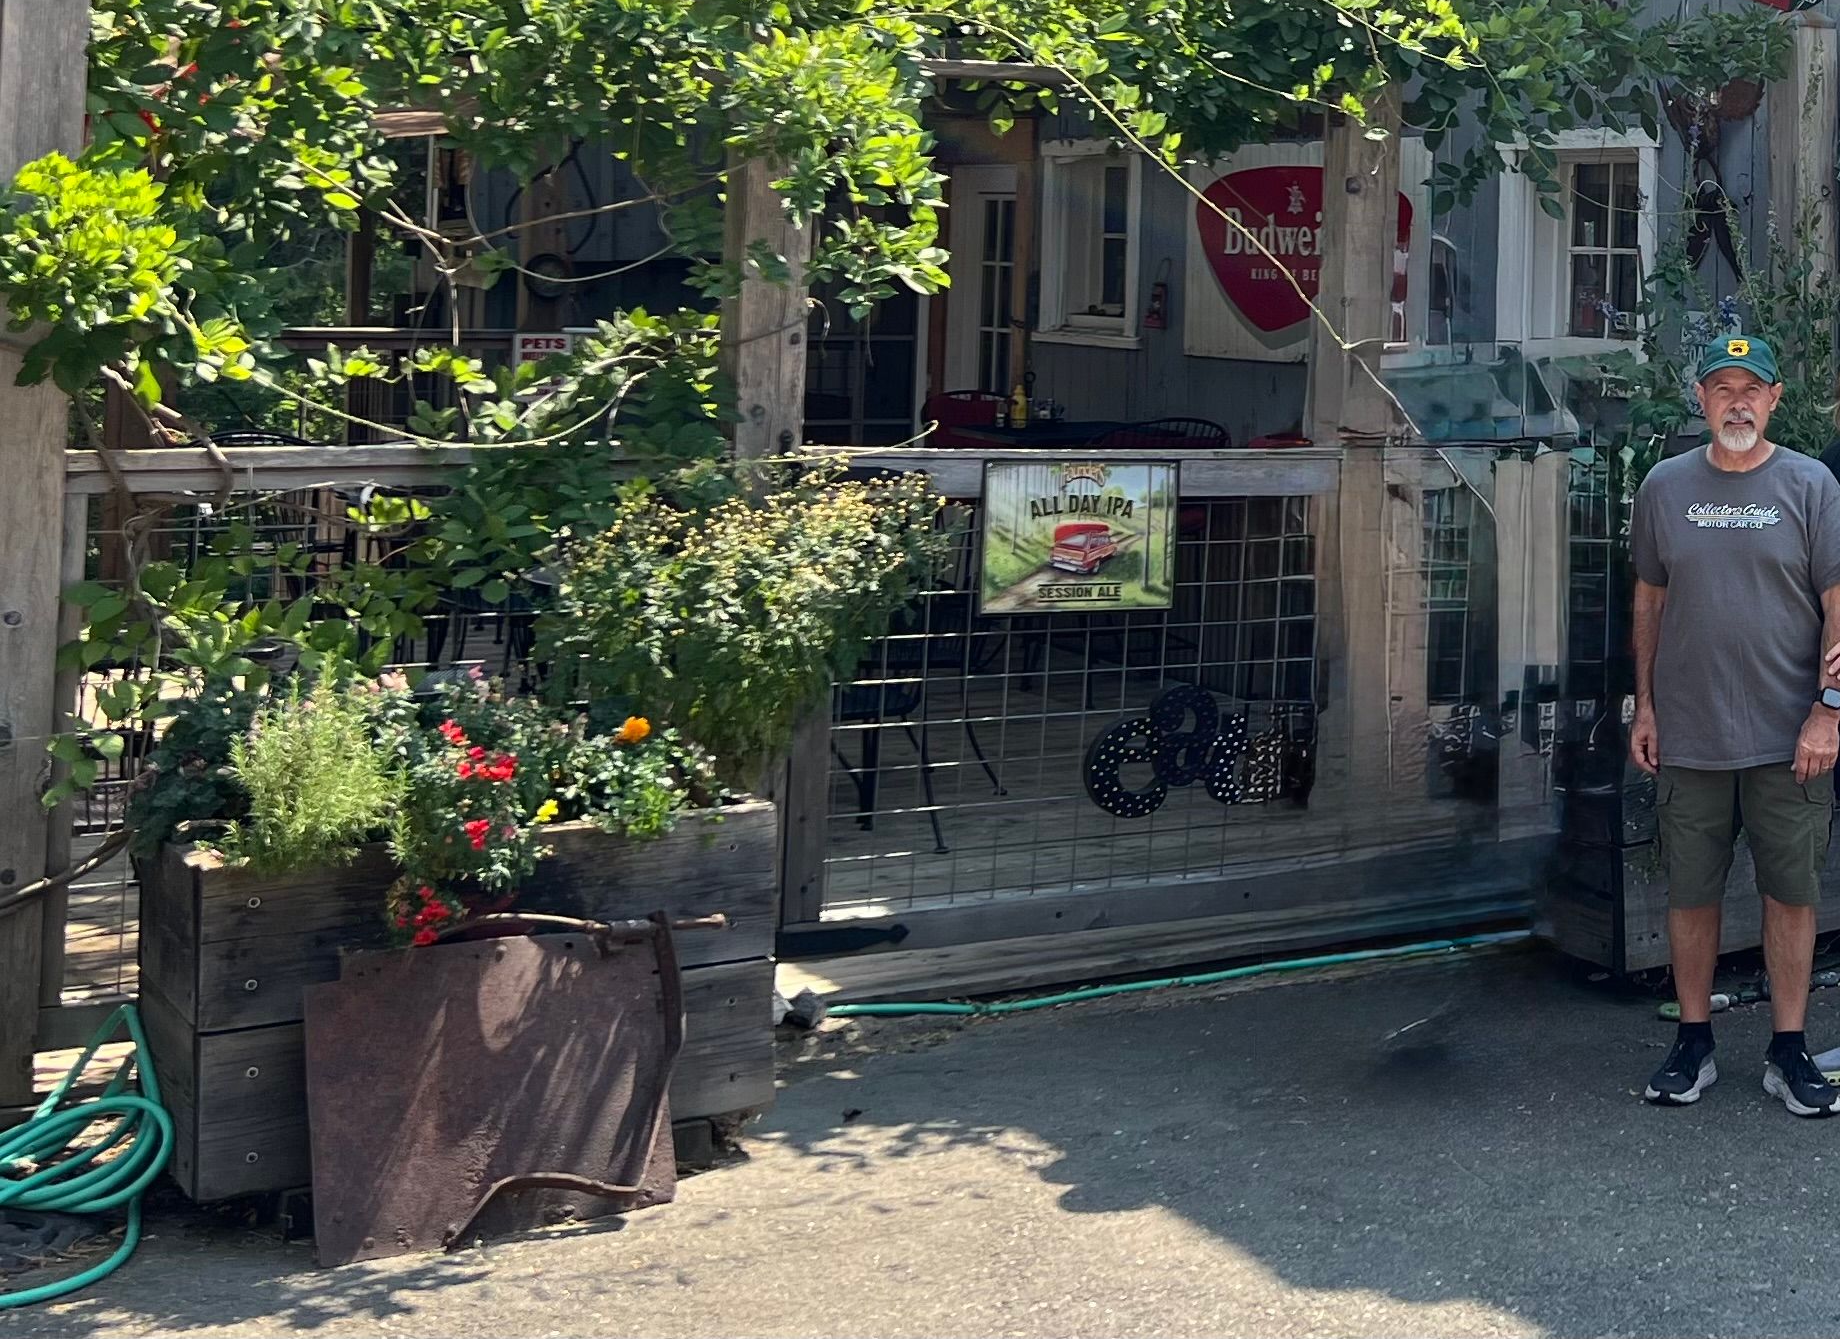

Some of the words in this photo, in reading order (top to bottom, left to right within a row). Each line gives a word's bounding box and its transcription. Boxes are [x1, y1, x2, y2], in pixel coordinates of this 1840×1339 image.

[521, 338, 567, 350] PETS
[1062, 463, 1106, 487] Founders
[1030, 495, 1062, 520] ALL
[1068, 494, 1102, 514] DAY
[1107, 496, 1136, 519] IPA
[1743, 503, 1779, 518] Guide
[1697, 519, 1729, 529] MOTOR
[1730, 520, 1749, 529] CAR
[1038, 586, 1093, 600] SESSION
[1097, 585, 1122, 597] ALE
